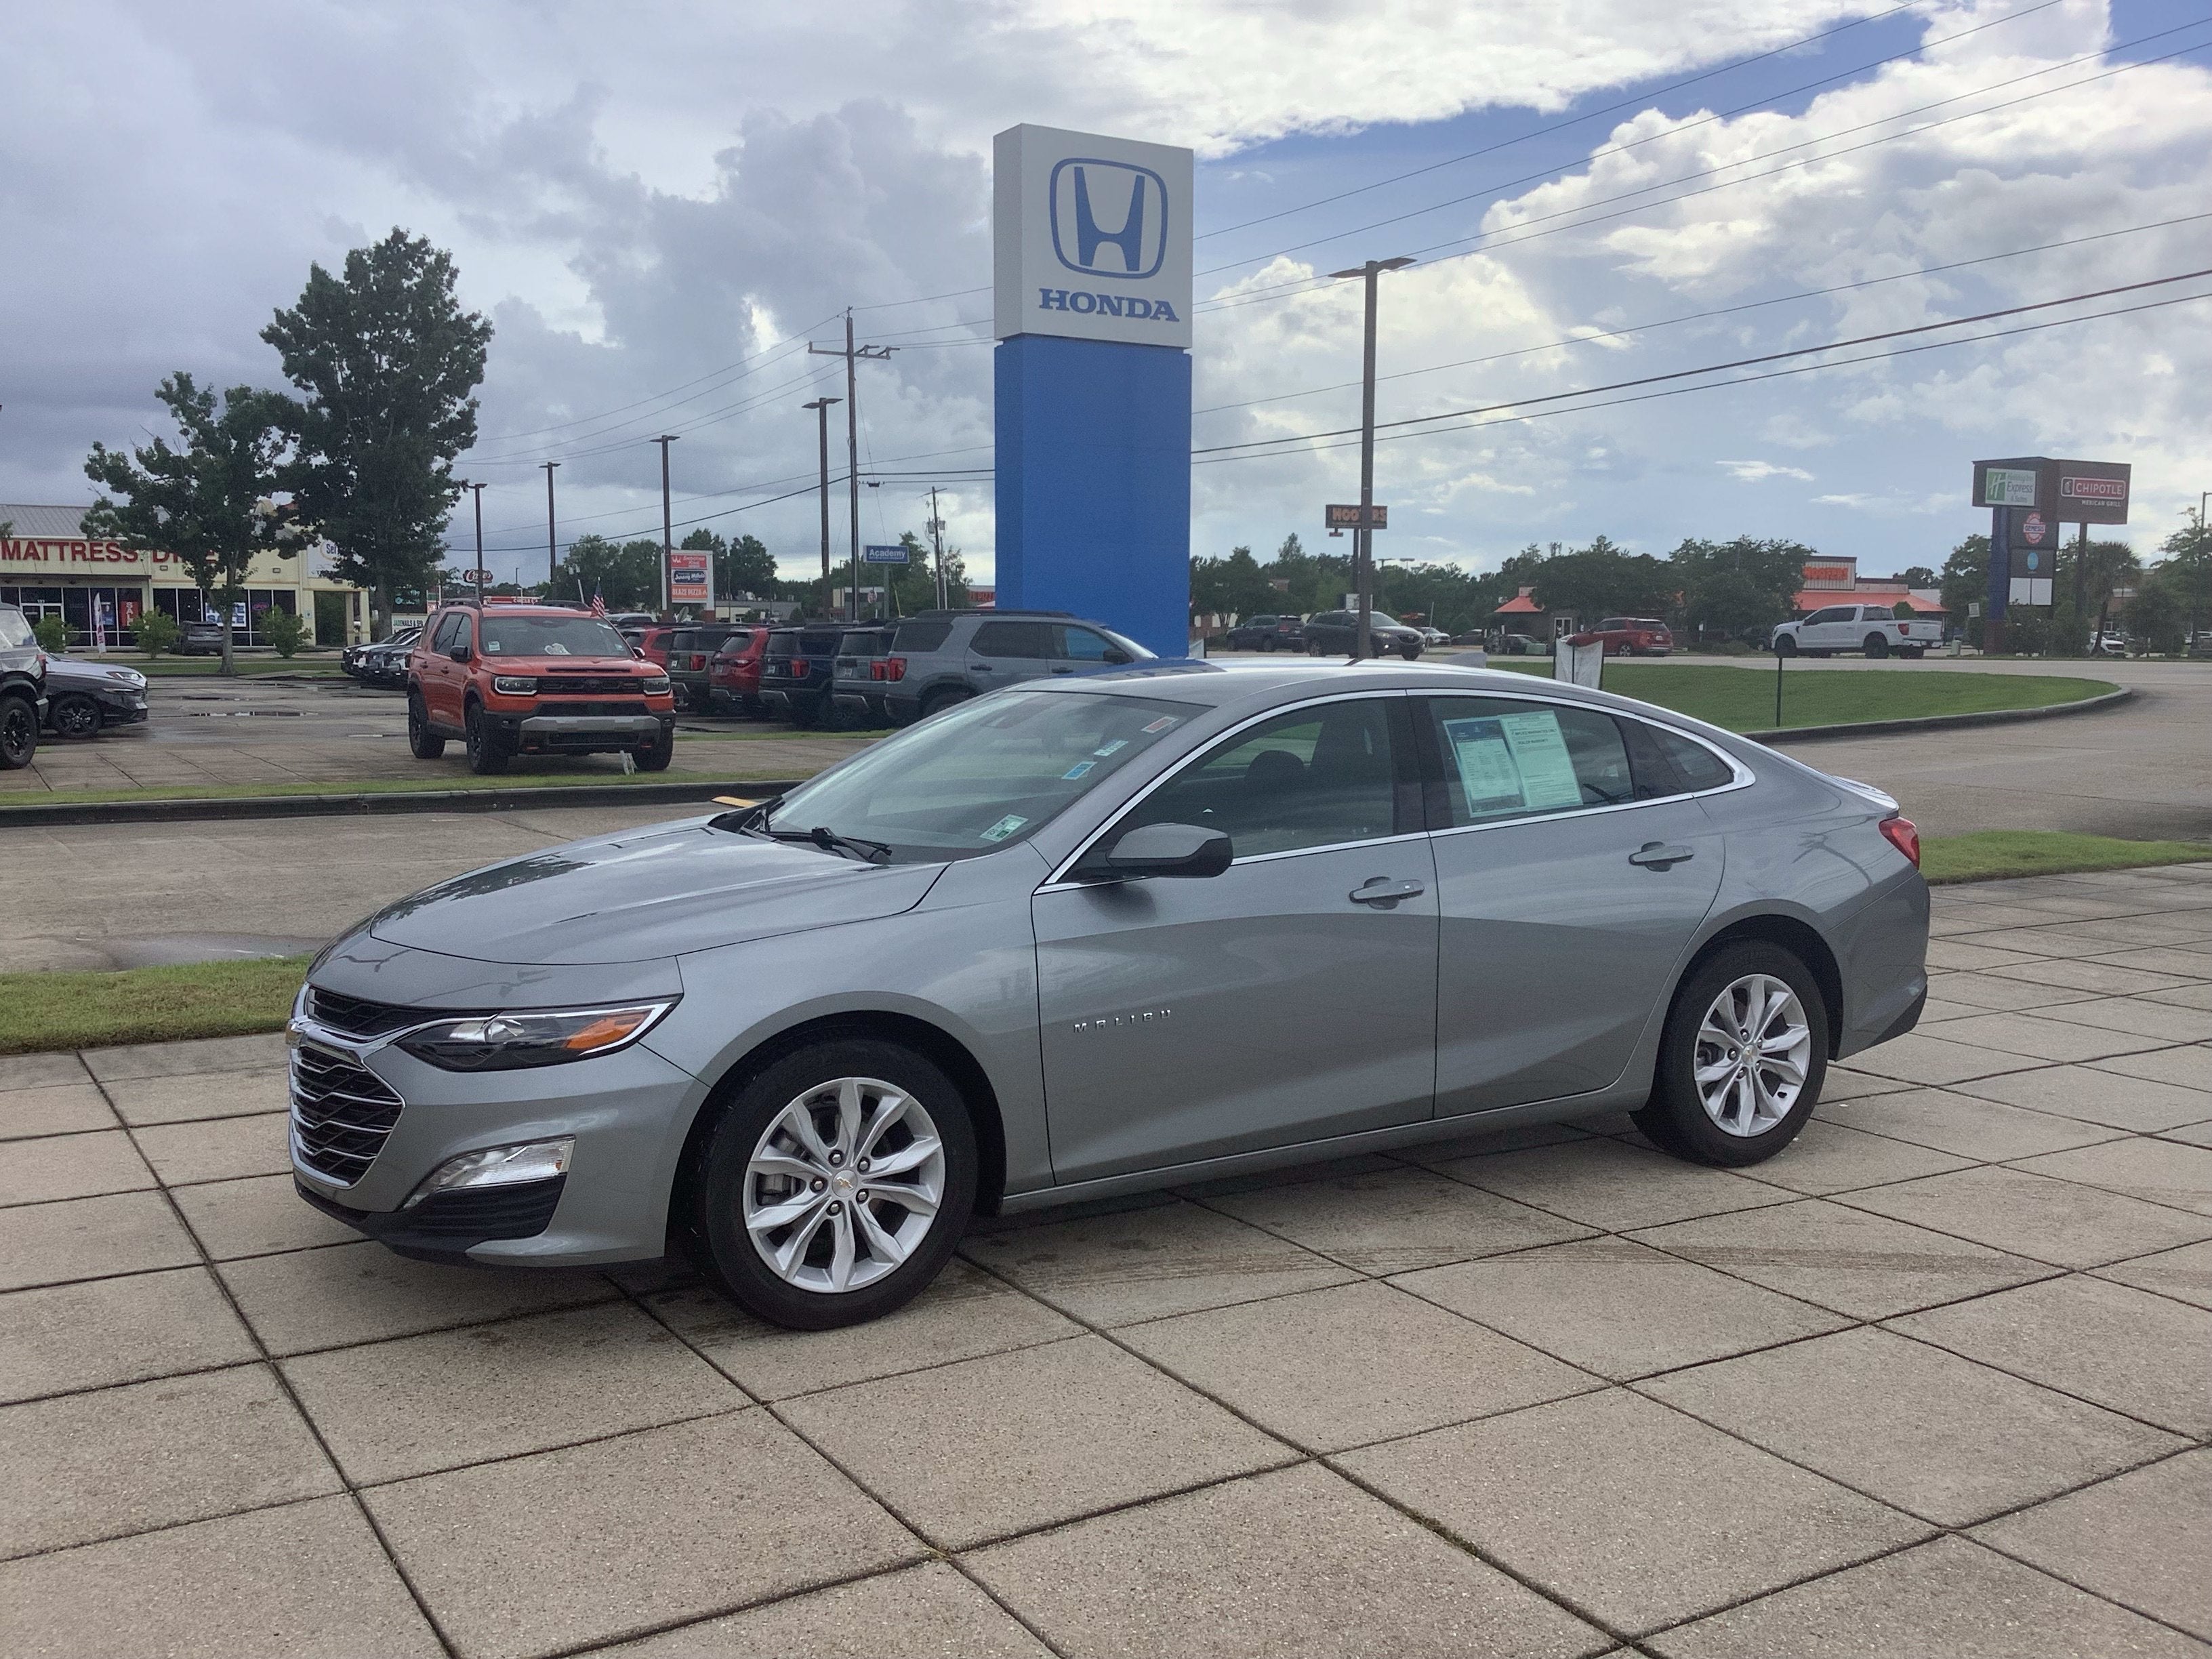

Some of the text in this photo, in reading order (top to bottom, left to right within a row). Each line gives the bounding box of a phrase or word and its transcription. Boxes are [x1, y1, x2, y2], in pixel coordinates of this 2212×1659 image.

[1039, 288, 1180, 322] HONDA
[2007, 482, 2033, 495] Express
[2076, 483, 2123, 495] CHIPOTLE
[869, 548, 905, 559] Academy
[1073, 1010, 1171, 1033] MALIBU
